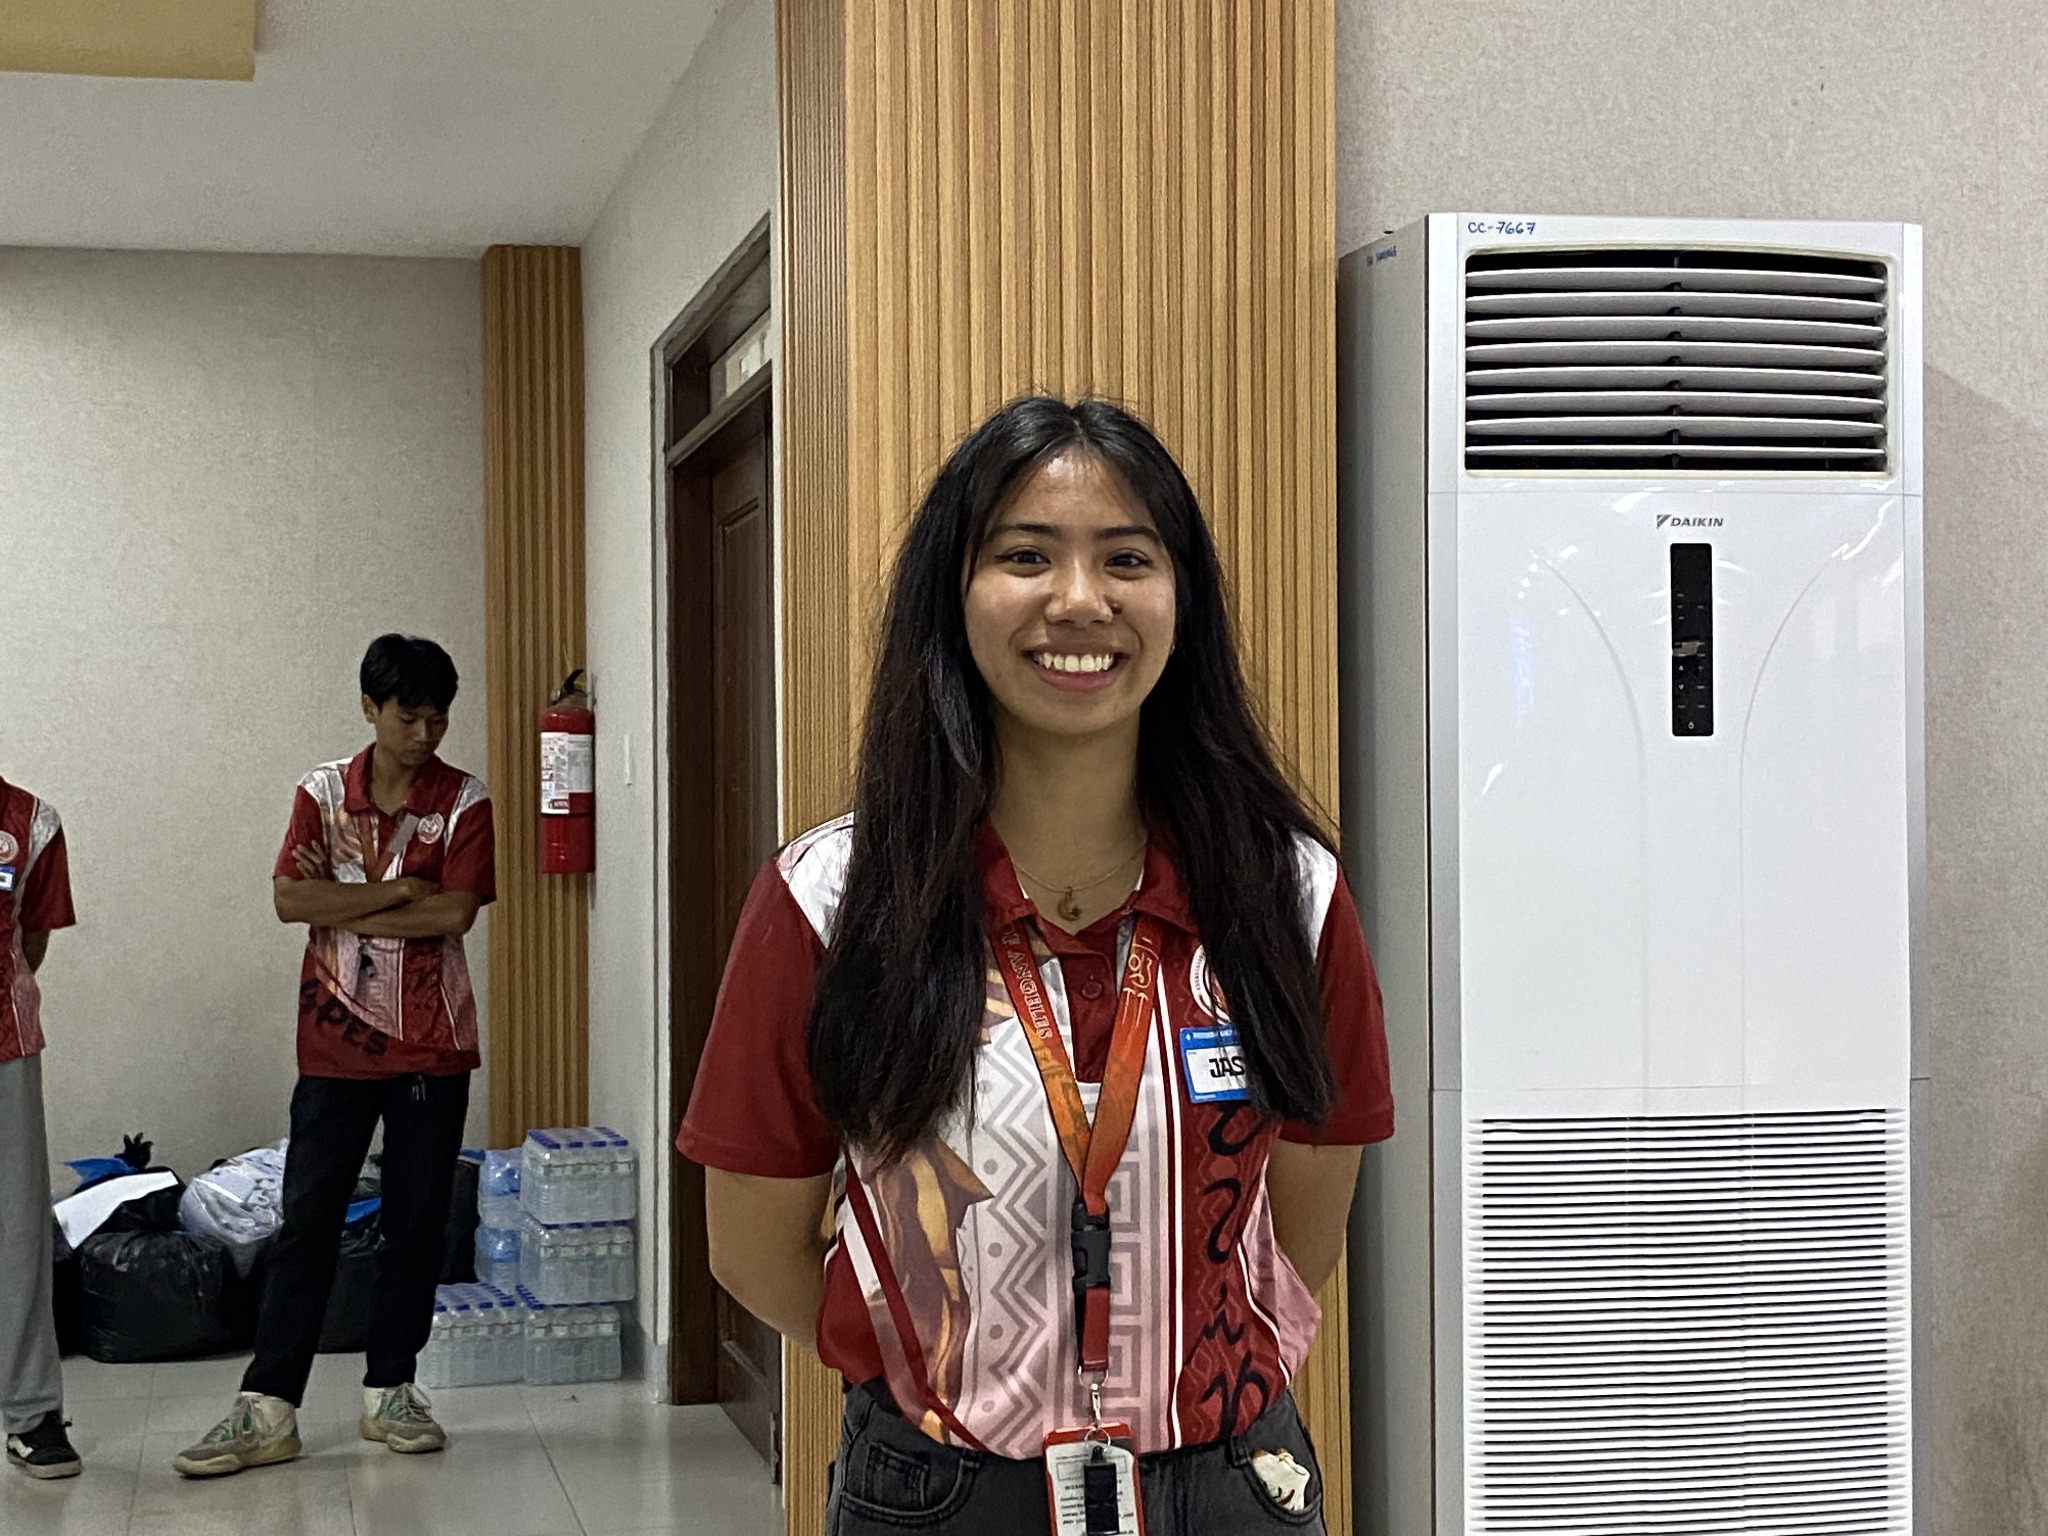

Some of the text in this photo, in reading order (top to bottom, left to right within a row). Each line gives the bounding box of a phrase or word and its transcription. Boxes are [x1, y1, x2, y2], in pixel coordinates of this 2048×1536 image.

[1467, 220, 1536, 235] CC-7667
[1670, 517, 1724, 527] DAIKIN
[1007, 950, 1053, 1039] ANGELES
